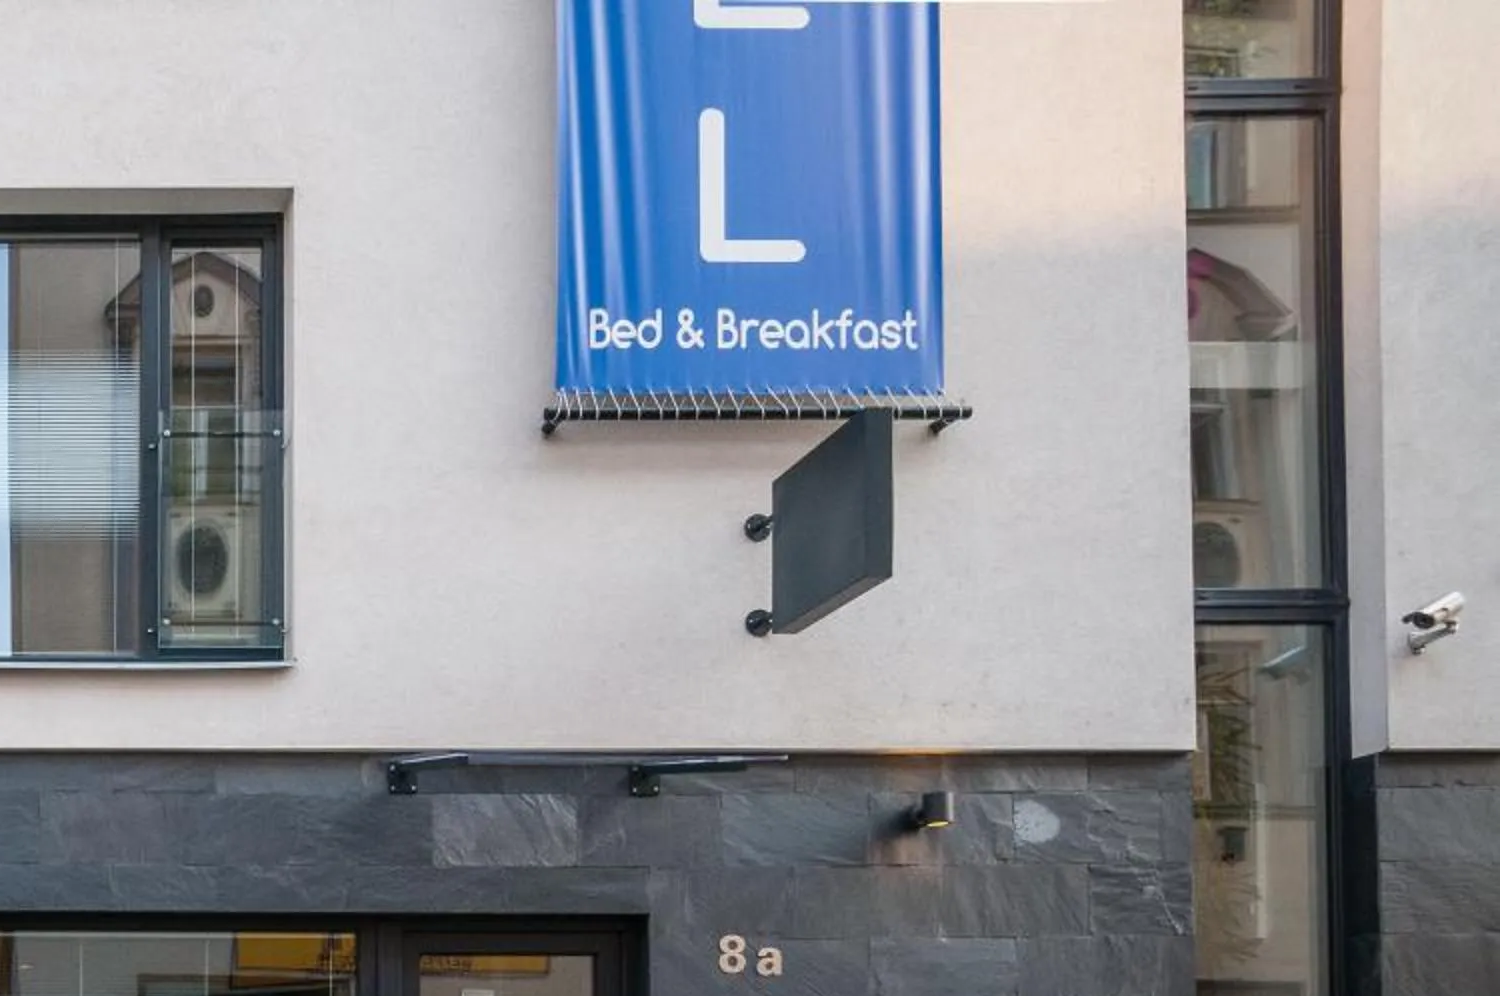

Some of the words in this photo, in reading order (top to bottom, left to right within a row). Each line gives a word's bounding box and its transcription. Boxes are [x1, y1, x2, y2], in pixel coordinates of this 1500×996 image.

[588, 307, 663, 350] Bed
[675, 307, 705, 350] &
[716, 307, 919, 350] Breakfast
